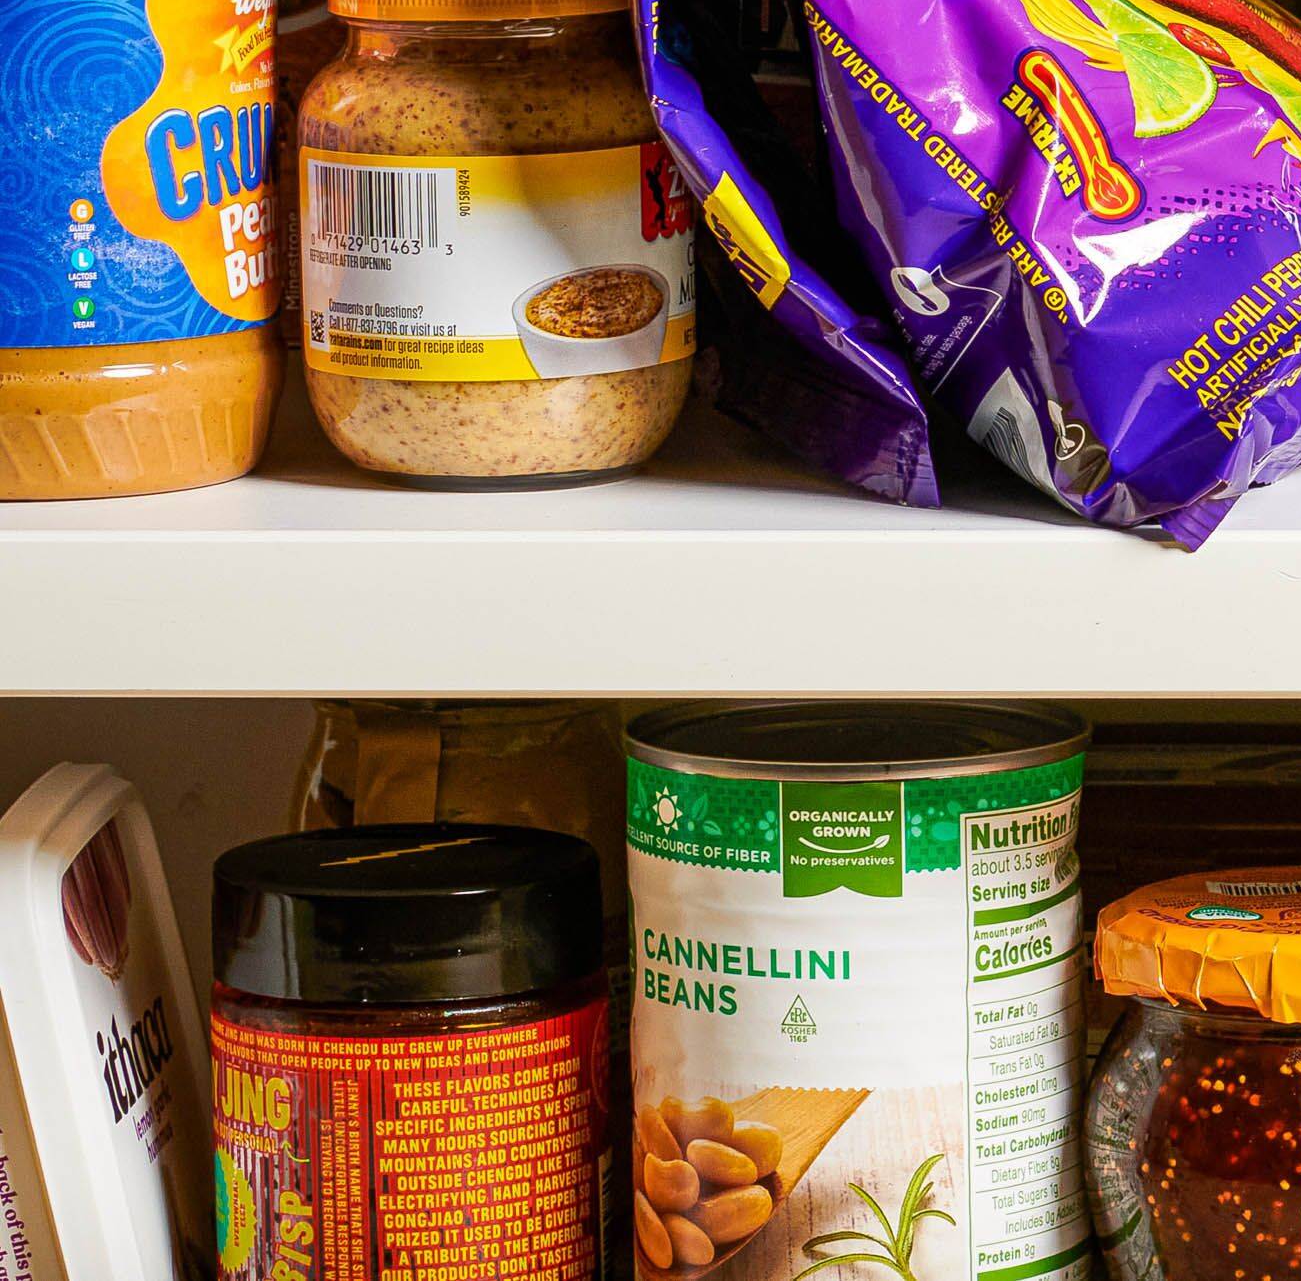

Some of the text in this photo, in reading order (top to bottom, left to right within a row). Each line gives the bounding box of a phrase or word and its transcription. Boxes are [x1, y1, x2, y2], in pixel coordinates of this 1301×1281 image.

[803, 1, 930, 142] TRADEMARKS
[1002, 82, 1083, 198] EXTREME
[459, 169, 470, 217] 901589424
[69, 223, 94, 233] GLUTEN
[73, 231, 91, 241] FREE
[326, 233, 421, 255] 71429 01463
[360, 257, 392, 270] OPENING
[68, 272, 97, 282] LACTOSE
[74, 280, 92, 290] FREE
[374, 304, 424, 318] Questions?
[72, 321, 95, 330] VEGAN
[398, 340, 484, 354] great recipe ideas
[1167, 333, 1222, 390] HOT
[1213, 284, 1277, 346] CHILI
[370, 351, 423, 370] information.
[789, 810, 894, 823] ORGANICALLY
[812, 824, 871, 838] GROWN
[971, 810, 1068, 849] Nutrition
[655, 837, 771, 864] SOURCE OF FIBER
[790, 855, 895, 869] No preservatives
[643, 928, 851, 980] CANNELLINI
[974, 933, 1053, 972] Calories
[643, 967, 738, 1016] BEANS
[323, 1028, 538, 1055] CHENGDU EVERYWHERE
[781, 1026, 817, 1036] KOSHER
[97, 996, 174, 1124] ithaca
[393, 1071, 510, 1098] THESE FLAVORS
[400, 1083, 553, 1117] CAREFUL TECHNIQUES
[976, 1113, 1019, 1131] Sodium
[383, 1131, 485, 1154] MANY HOURS
[10, 1229, 32, 1271] this
